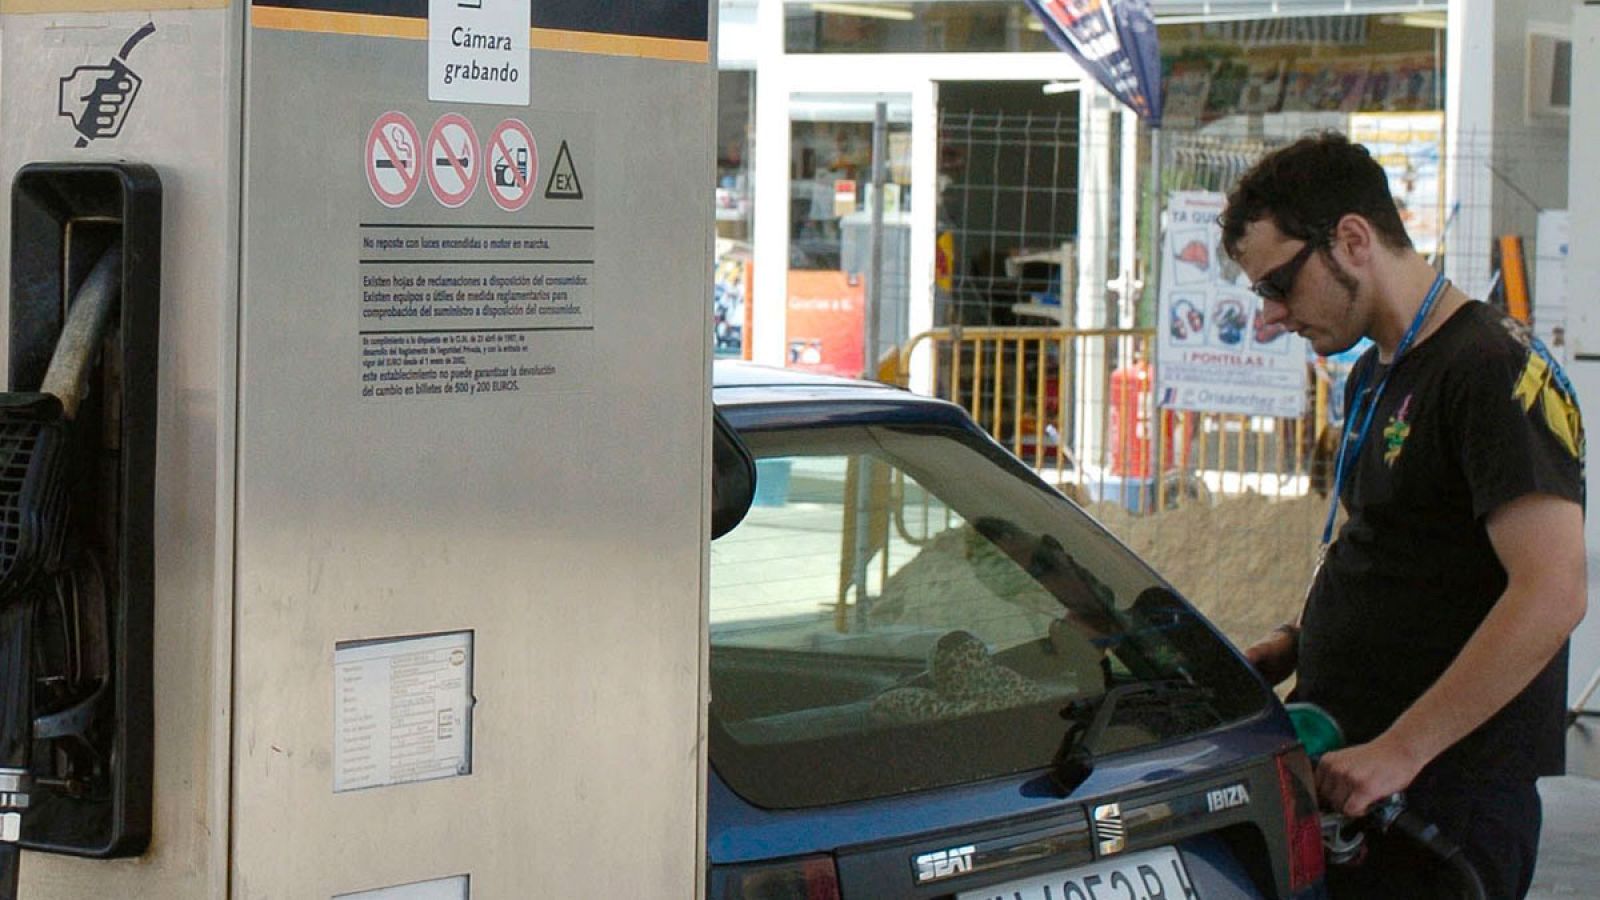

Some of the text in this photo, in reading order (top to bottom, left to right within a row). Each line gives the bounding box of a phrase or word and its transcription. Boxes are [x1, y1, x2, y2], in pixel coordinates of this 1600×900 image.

[451, 27, 512, 50] Cámara
[444, 61, 519, 84] grabando
[556, 175, 573, 191] EX
[363, 237, 375, 249] No
[376, 237, 404, 251] reposte
[405, 239, 419, 249] con
[421, 236, 440, 249] luces
[442, 237, 481, 249] encendidas
[483, 240, 489, 249] o
[490, 238, 511, 249] motor
[512, 240, 521, 249] en
[363, 275, 391, 287] Existen
[393, 274, 414, 289] hojas
[416, 275, 426, 287] de
[427, 275, 481, 287] reclamaciones
[483, 278, 488, 286] a
[489, 274, 531, 288] disposición
[532, 274, 545, 286] del
[363, 291, 391, 302] Existen
[392, 291, 424, 305] equipos
[433, 290, 454, 301] útiles
[455, 290, 465, 301] de
[467, 290, 495, 301] medida
[496, 289, 550, 304] reglamentarios
[551, 291, 568, 302] para
[362, 304, 418, 320] comprobación
[420, 304, 432, 317] del
[433, 304, 474, 317] suministro
[475, 308, 481, 316] a
[482, 304, 524, 318] disposición
[525, 304, 537, 315] del
[363, 363, 556, 382] este establecimiento no puede garantizar la devolución
[362, 379, 520, 397] del cambio en billetes de 500 y 200 EUROS.
[1207, 784, 1250, 813] IBIZA
[915, 845, 976, 881] SEAT
